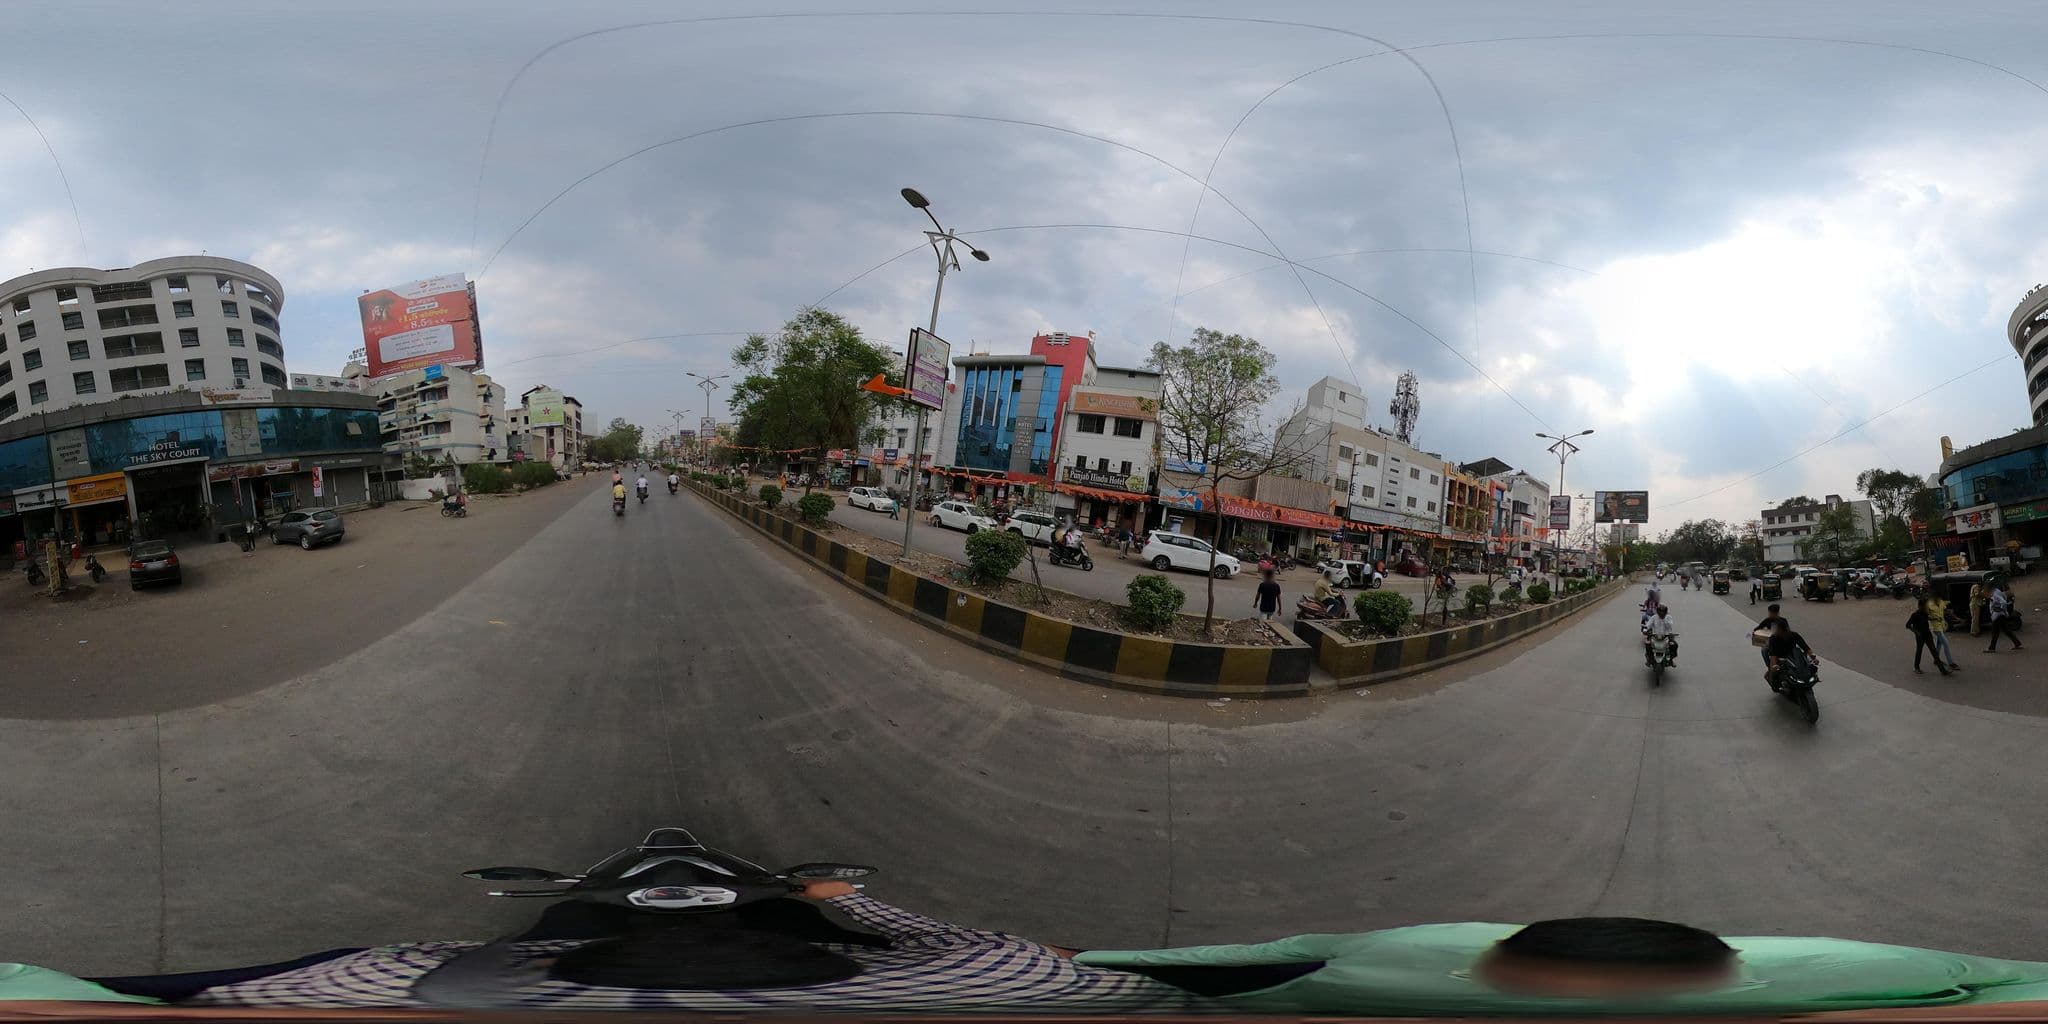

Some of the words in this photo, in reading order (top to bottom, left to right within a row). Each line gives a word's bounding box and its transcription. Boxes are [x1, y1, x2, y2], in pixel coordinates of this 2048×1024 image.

[149, 441, 180, 452] HOTEL
[130, 454, 149, 464] THE
[150, 451, 168, 462] SKY
[169, 448, 201, 459] COURT
[1070, 470, 1090, 482] Punjab
[1090, 472, 1109, 484] Hindu
[1109, 475, 1125, 486] Hotel
[1220, 503, 1270, 519] LODGING
